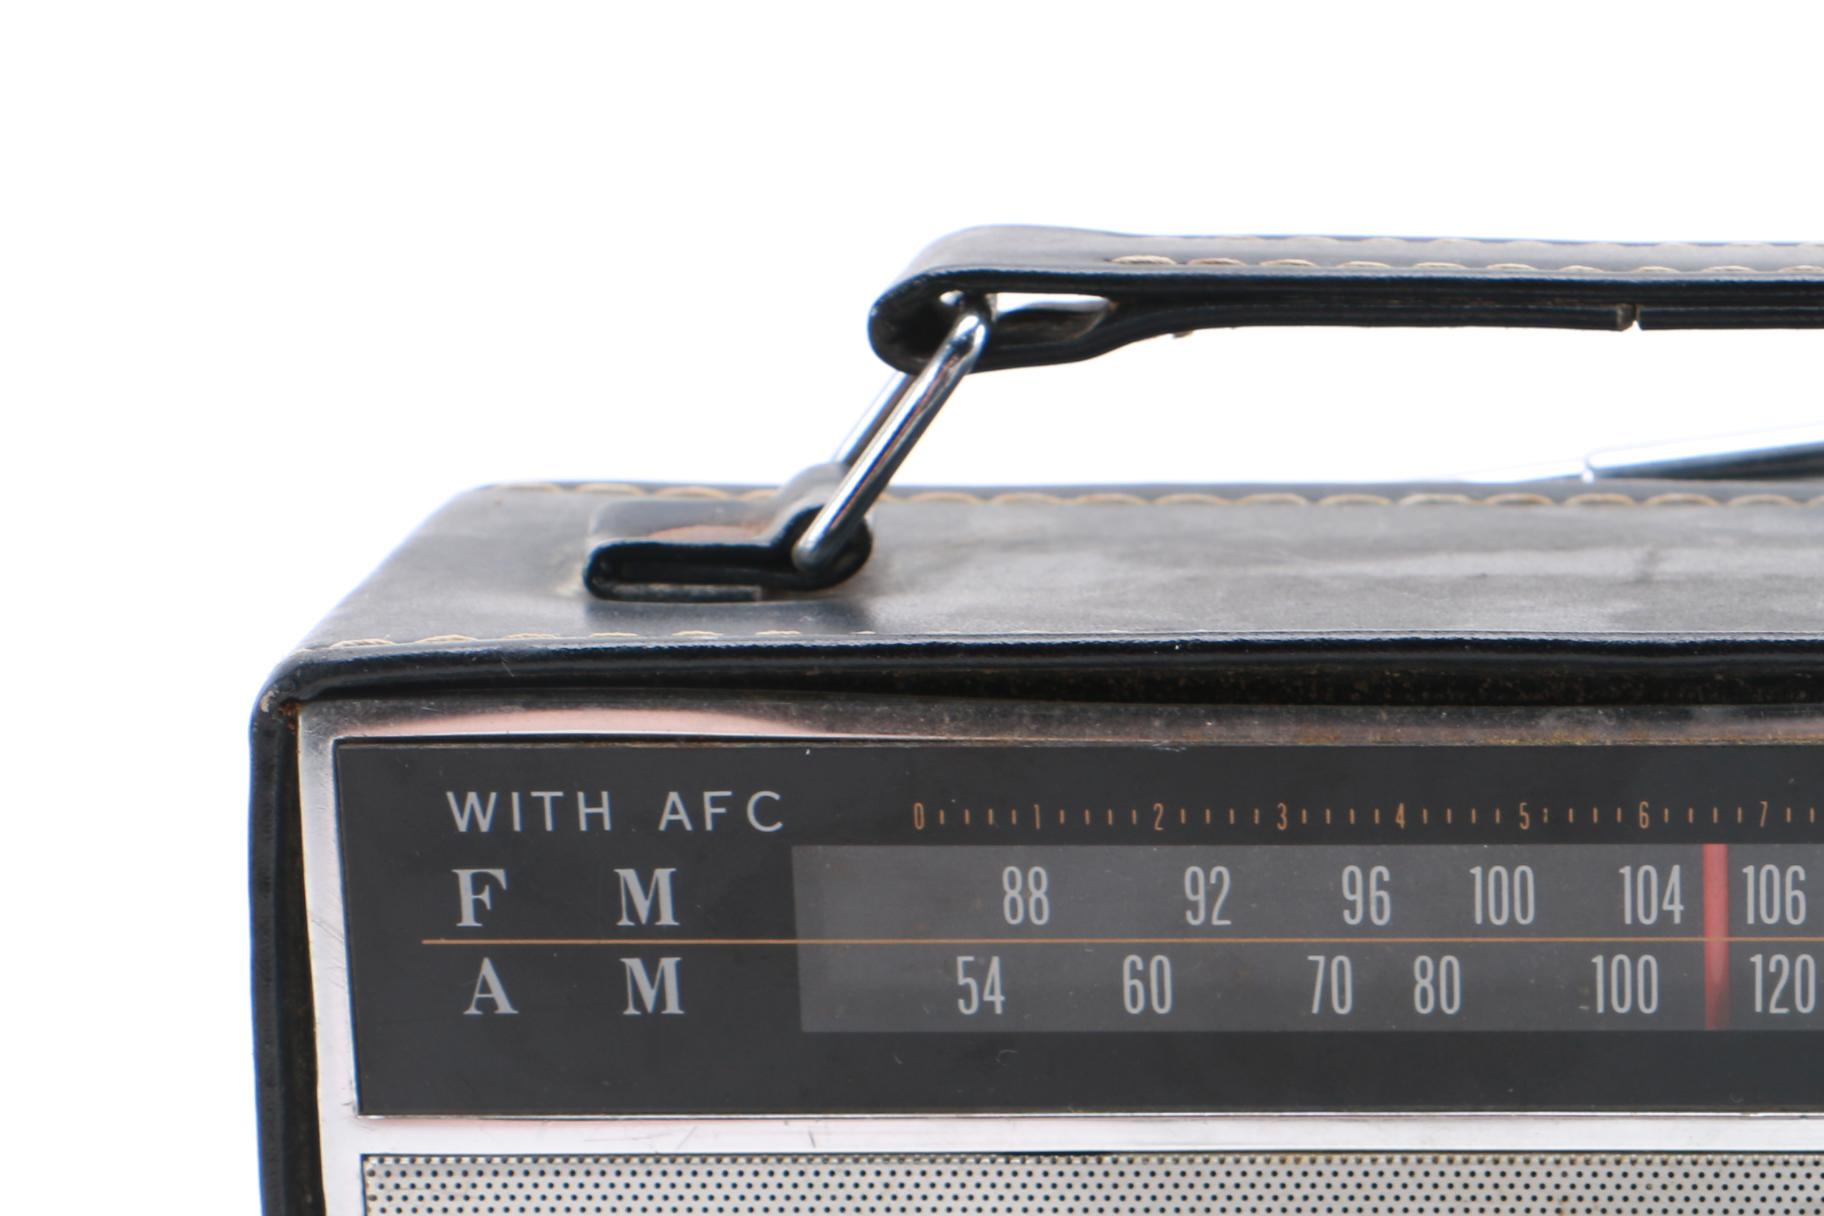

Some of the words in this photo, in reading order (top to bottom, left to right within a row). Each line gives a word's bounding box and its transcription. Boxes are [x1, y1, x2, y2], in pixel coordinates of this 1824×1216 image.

[447, 791, 611, 832] WITH
[659, 791, 783, 832] AFC
[912, 802, 925, 830] 0
[1153, 802, 1164, 831] 2
[1276, 802, 1288, 831] 3
[1395, 803, 1406, 829] 4
[1519, 802, 1530, 831] 5
[1638, 800, 1650, 829] 6
[1003, 866, 1050, 925] 88
[1184, 866, 1231, 925] 92
[1342, 865, 1390, 925] 96
[1470, 865, 1534, 925] 100
[1619, 865, 1684, 925] 104
[1743, 864, 1806, 925] 106
[957, 956, 1005, 1014] 54
[1123, 955, 1172, 1014] 60
[1308, 955, 1352, 1014] 70
[1414, 955, 1460, 1014] 80
[1592, 954, 1658, 1013] 100
[1750, 954, 1815, 1013] 120
